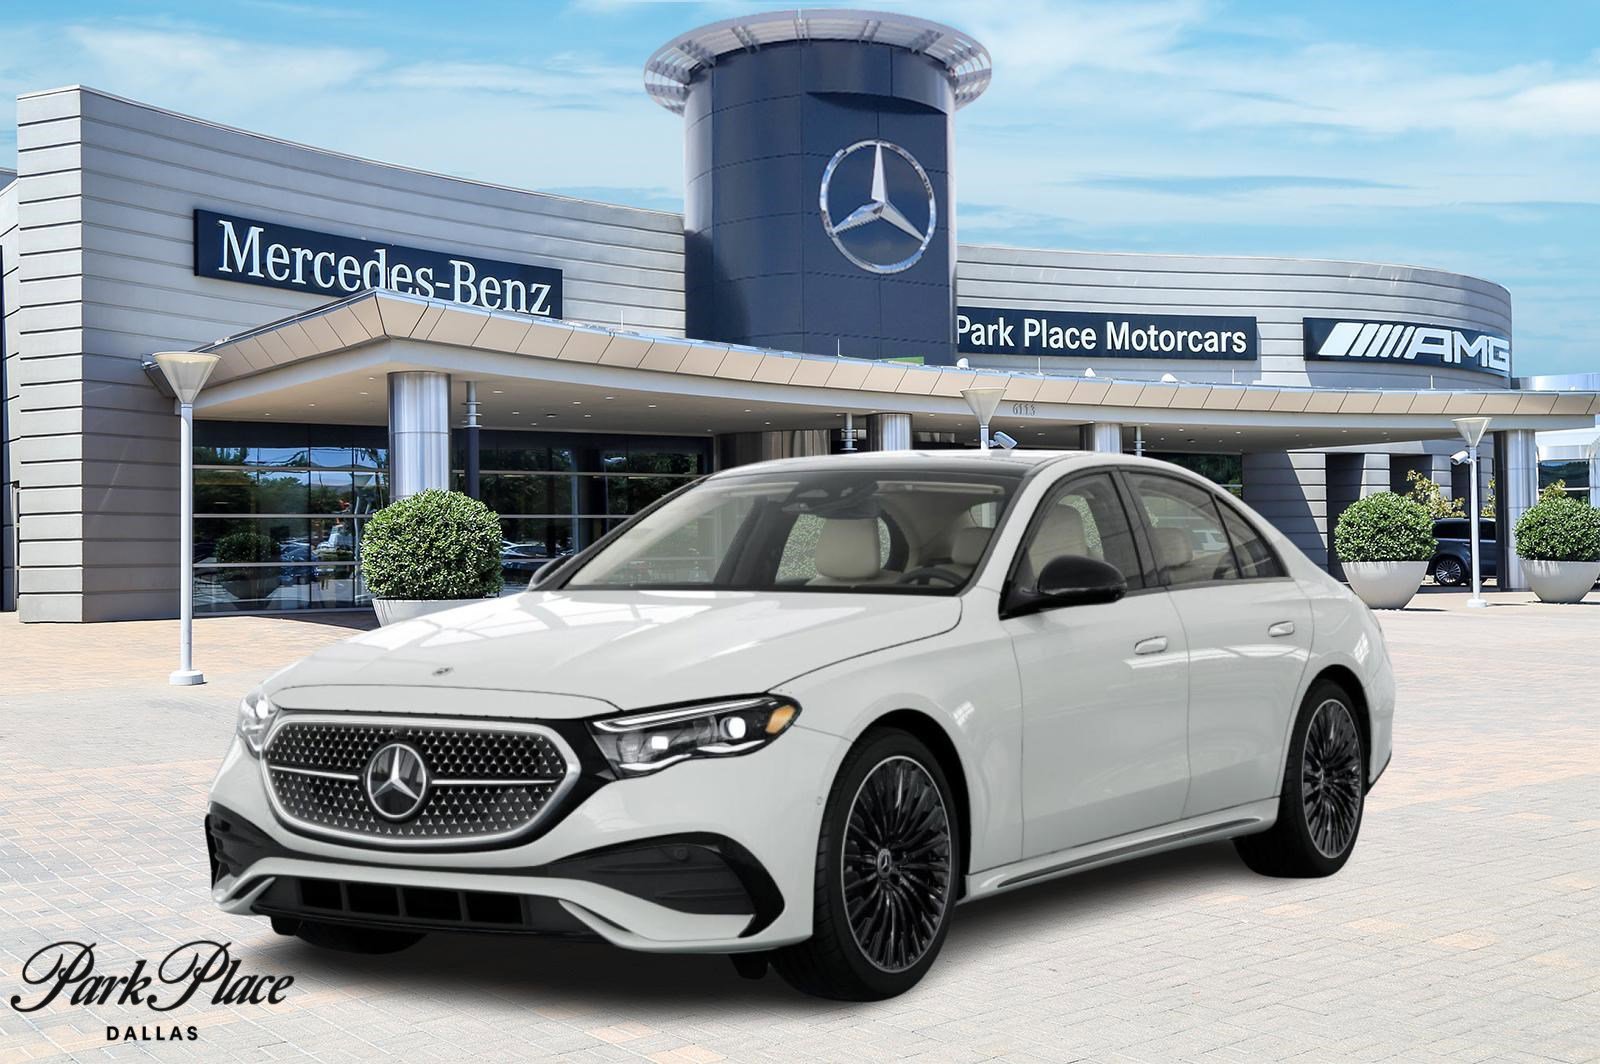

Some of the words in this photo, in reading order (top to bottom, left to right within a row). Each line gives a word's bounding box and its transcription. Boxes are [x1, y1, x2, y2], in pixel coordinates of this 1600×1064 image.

[217, 219, 552, 316] Mercedes-Benz
[956, 314, 1015, 347] Park
[1023, 318, 1097, 350] Place
[1106, 321, 1248, 353] Motorcars
[1404, 327, 1510, 371] AMG
[1012, 402, 1036, 416] 6113
